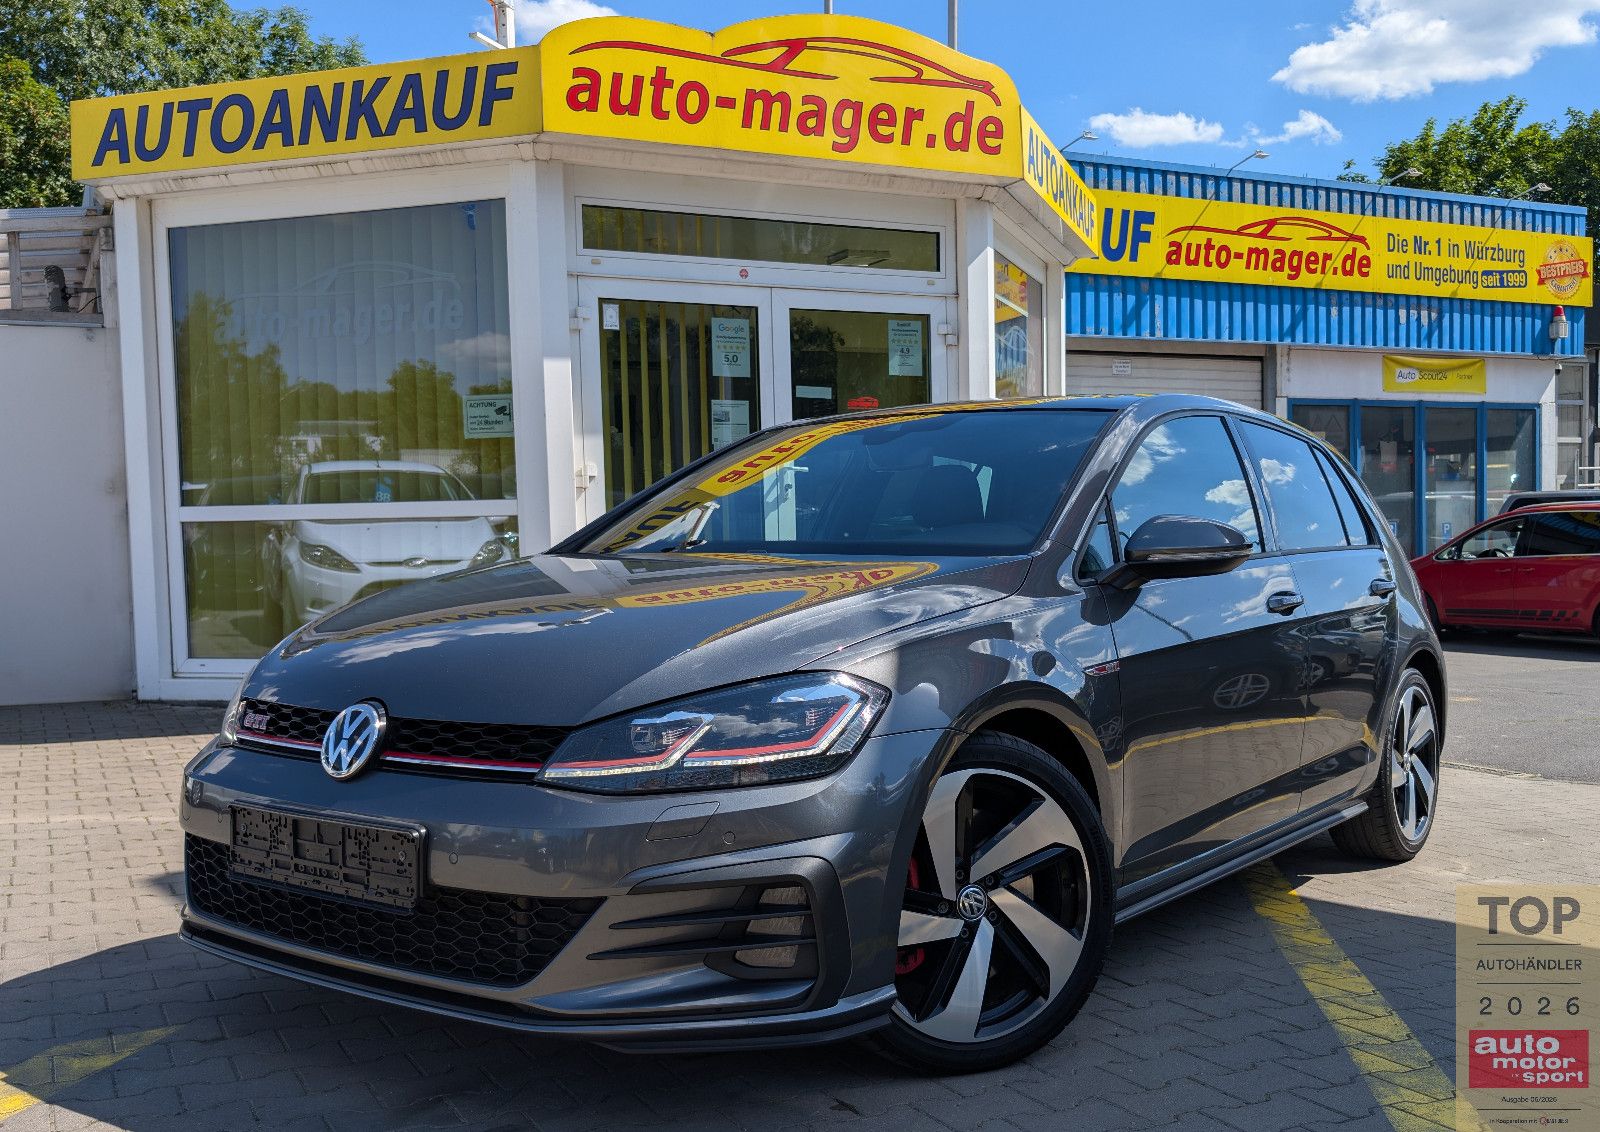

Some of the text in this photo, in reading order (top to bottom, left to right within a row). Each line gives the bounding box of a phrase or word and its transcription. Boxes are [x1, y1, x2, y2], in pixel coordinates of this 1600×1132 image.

[91, 61, 518, 167] AUTOANKAUF
[565, 66, 1004, 155] auto-mager.de
[1027, 126, 1096, 242] AUTOANKAUF
[1092, 207, 1155, 262] UF
[1387, 232, 1525, 269] Die Nr. 1 in Würzburg
[1165, 238, 1372, 281] auto-mager.de
[1387, 261, 1526, 290] und Umgebung seit 1999
[1540, 260, 1585, 279] BESTPREIS
[718, 323, 745, 335] Google
[1444, 523, 1450, 534] P
